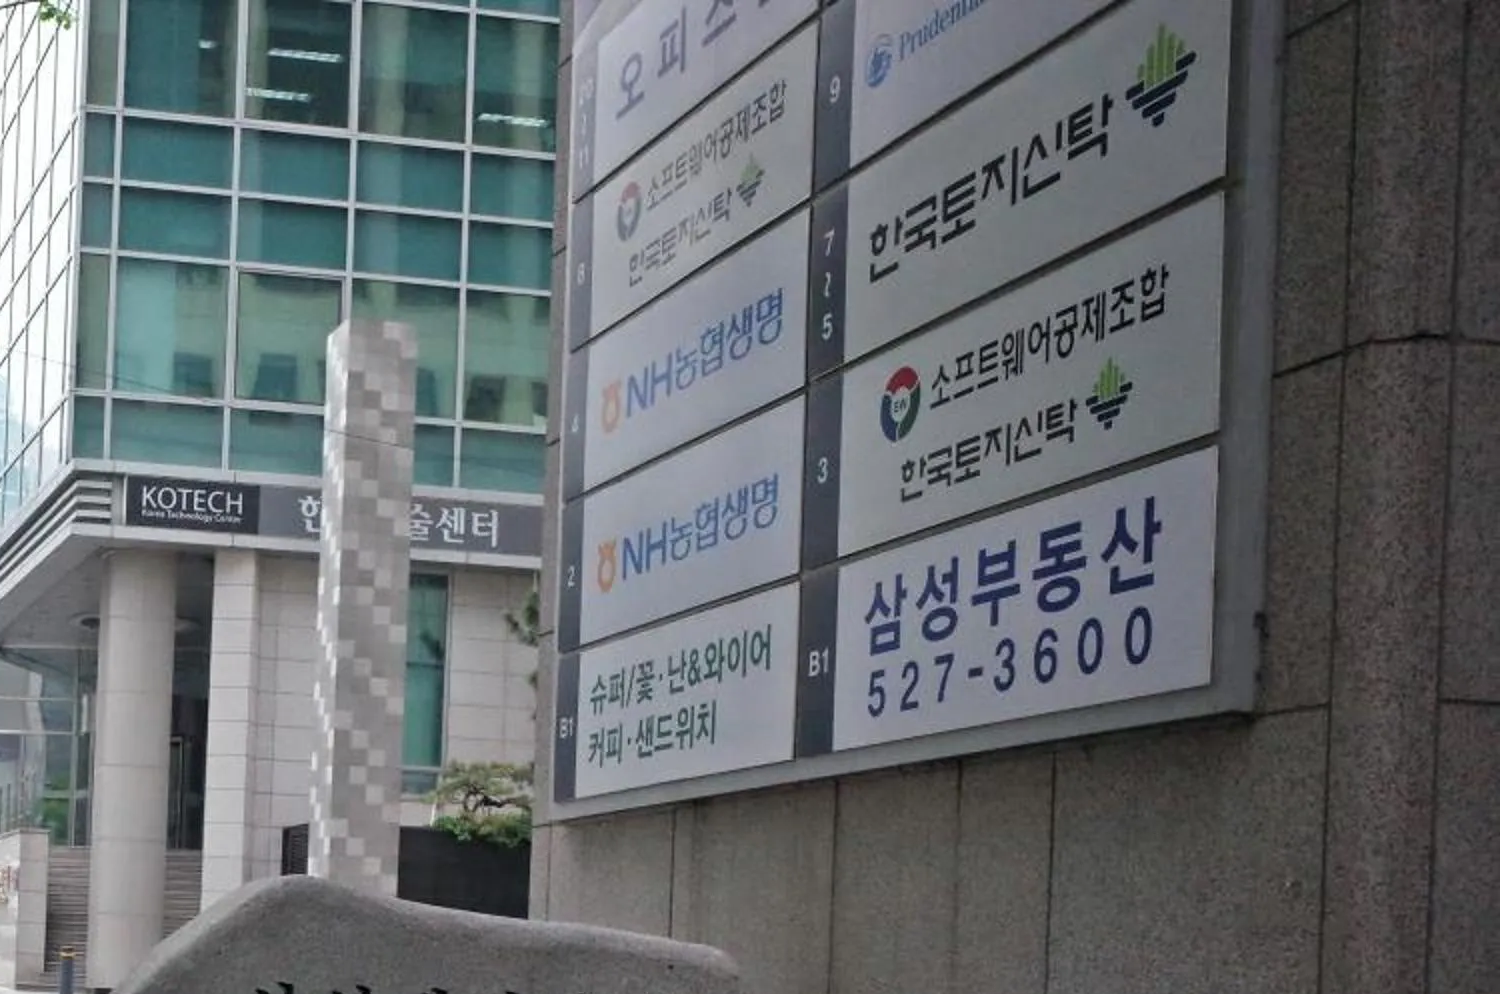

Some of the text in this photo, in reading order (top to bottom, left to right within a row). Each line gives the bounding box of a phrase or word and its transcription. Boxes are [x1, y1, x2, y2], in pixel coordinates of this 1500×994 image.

[615, 0, 772, 121] 오피스
[899, 0, 986, 61] Prudent
[829, 75, 841, 104] 9
[646, 79, 788, 211] 소프트웨어공제조합
[870, 92, 1114, 284] 한국토지신탁
[629, 187, 733, 288] 한국토지신탁
[625, 287, 784, 418] NH농협생명
[929, 263, 1170, 410] 소프트웨어공제조합
[140, 485, 244, 515] KOTECH
[817, 456, 829, 484] 3
[900, 397, 1078, 502] 한국토지신탁
[167, 510, 214, 525] Technology
[621, 472, 780, 581] NH농협생명
[566, 565, 577, 587] 2
[864, 495, 1162, 657] 삼성부동산
[807, 646, 830, 677] B1
[866, 606, 1153, 718] 527-3600
[558, 716, 574, 739] B1
